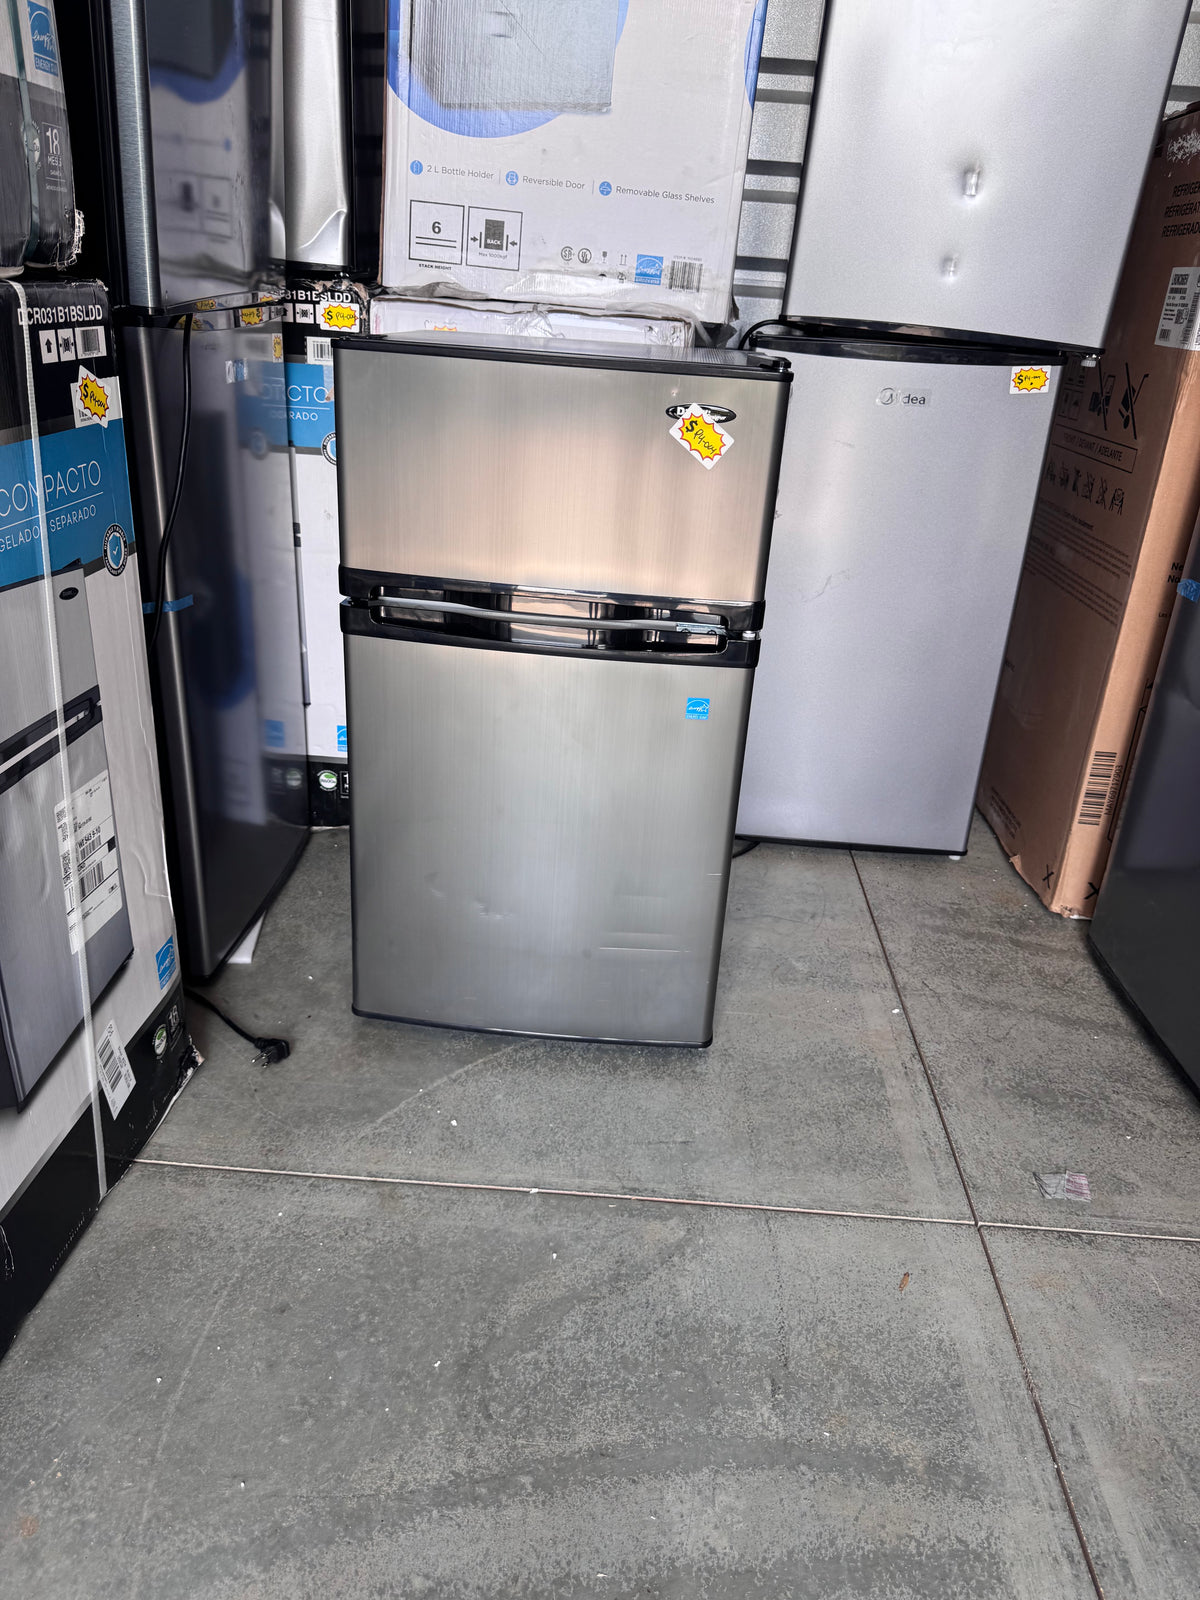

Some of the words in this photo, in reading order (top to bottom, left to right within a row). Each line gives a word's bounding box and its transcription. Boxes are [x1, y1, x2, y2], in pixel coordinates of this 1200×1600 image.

[46, 127, 60, 155] 18
[441, 167, 465, 176] Bottle
[468, 170, 494, 179] Holder
[522, 176, 563, 188] Reversible
[566, 180, 585, 189] Door
[616, 186, 660, 198] Removable
[662, 191, 683, 201] Glass
[684, 193, 715, 205] Shelves
[432, 221, 441, 234] 6
[327, 310, 333, 321] $
[1017, 374, 1023, 385] $
[83, 383, 88, 400] $
[685, 420, 698, 432] $
[50, 504, 97, 532] SEPARADO
